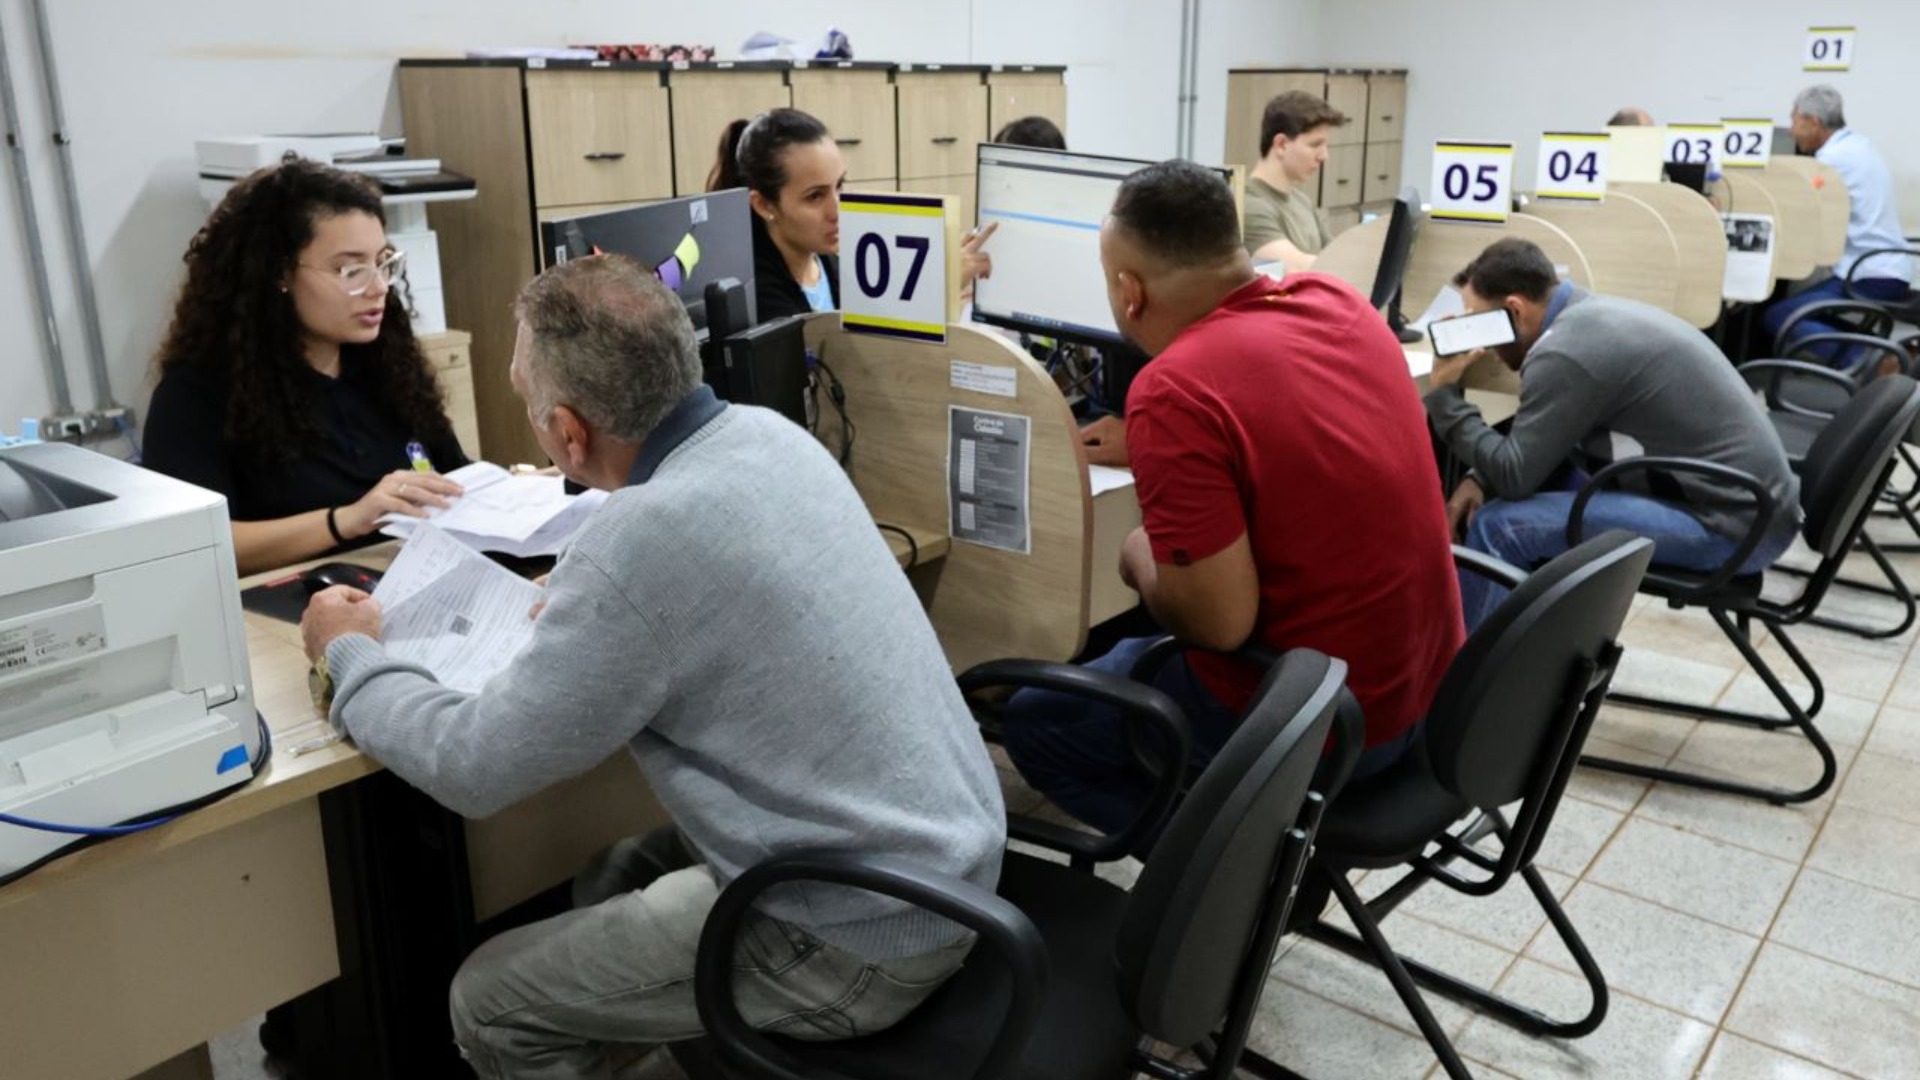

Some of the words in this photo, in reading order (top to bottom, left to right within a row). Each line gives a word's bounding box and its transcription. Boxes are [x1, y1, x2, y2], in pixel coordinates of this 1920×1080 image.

[1812, 39, 1843, 59] 01
[1671, 138, 1712, 163] 03
[1725, 132, 1762, 155] 02
[1549, 150, 1599, 183] 04
[1443, 163, 1498, 202] 05
[855, 232, 930, 301] 07
